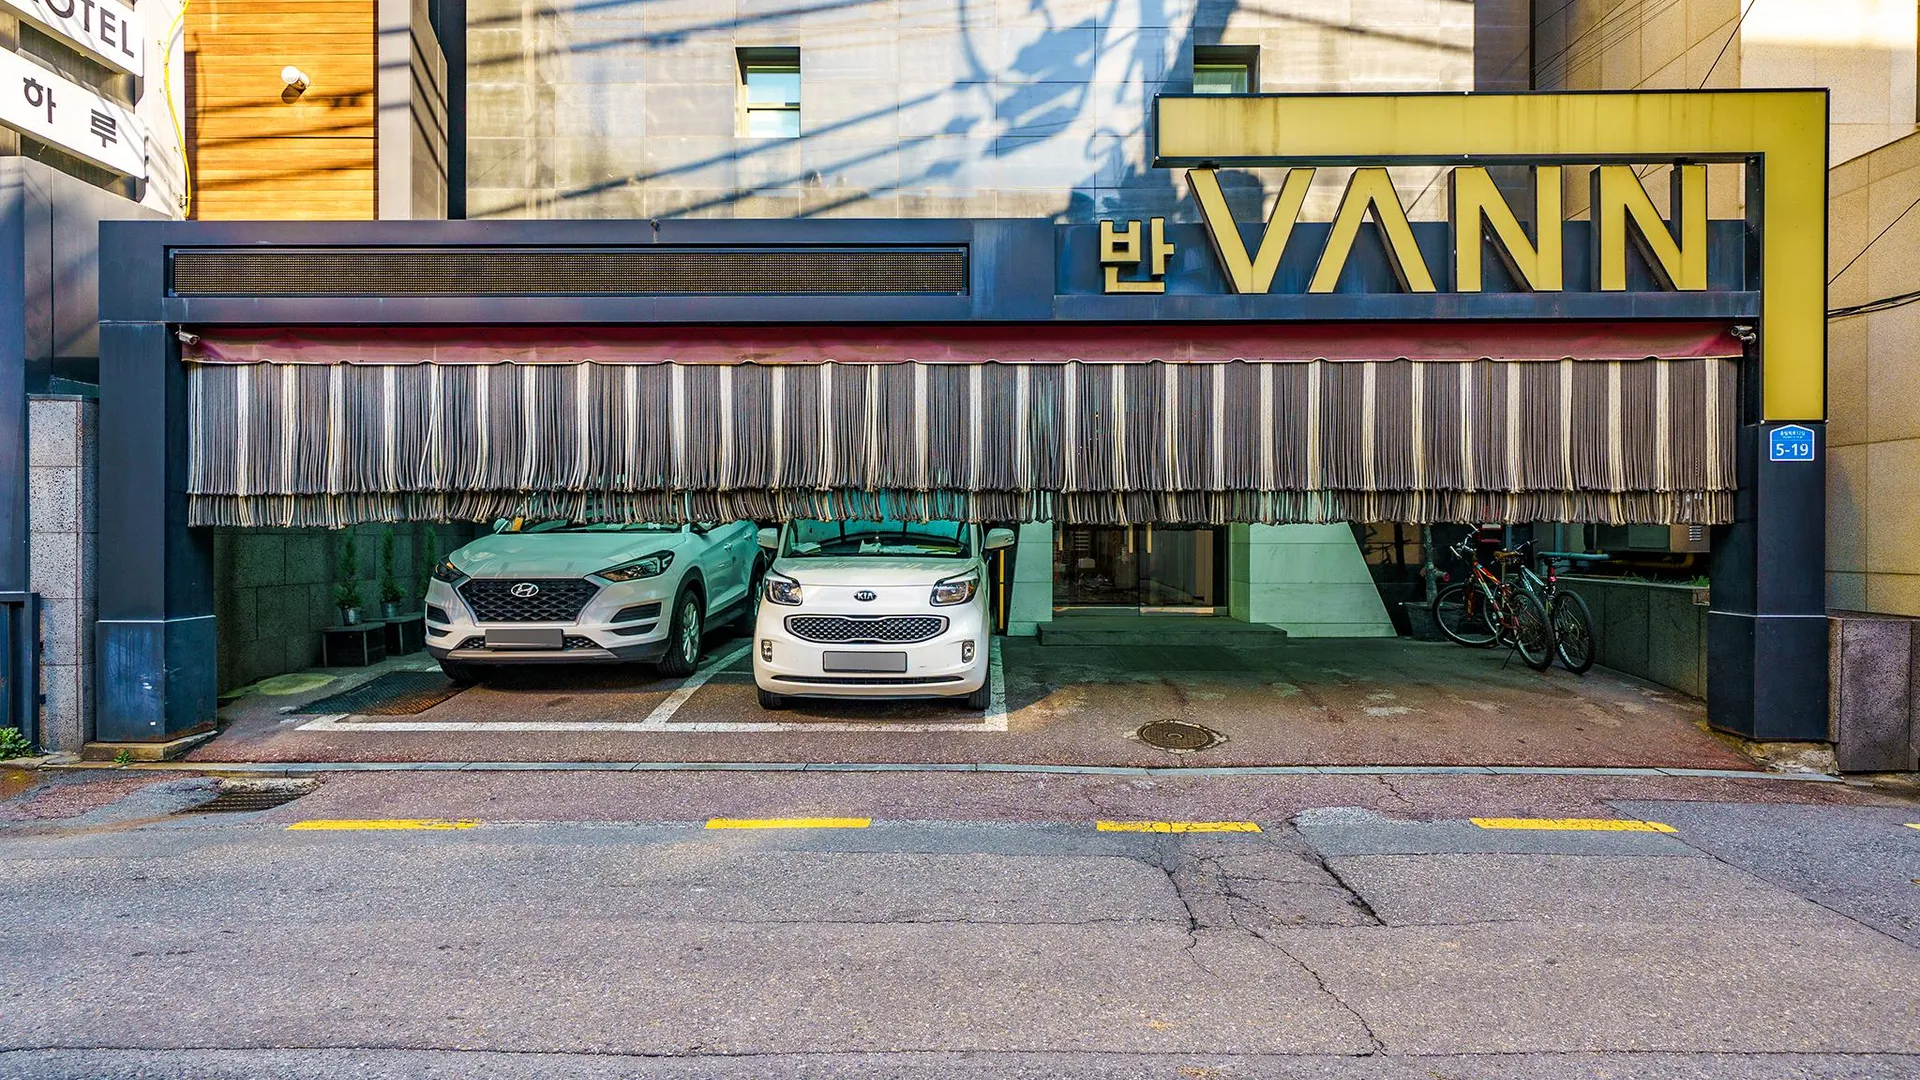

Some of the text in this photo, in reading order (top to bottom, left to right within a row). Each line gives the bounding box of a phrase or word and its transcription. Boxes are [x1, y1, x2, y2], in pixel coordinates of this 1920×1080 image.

[33, 0, 135, 58] OTEL
[1100, 217, 1175, 294] 반
[1186, 164, 1708, 294] VANN
[1775, 443, 1809, 456] 5-19
[856, 591, 874, 600] KIA
